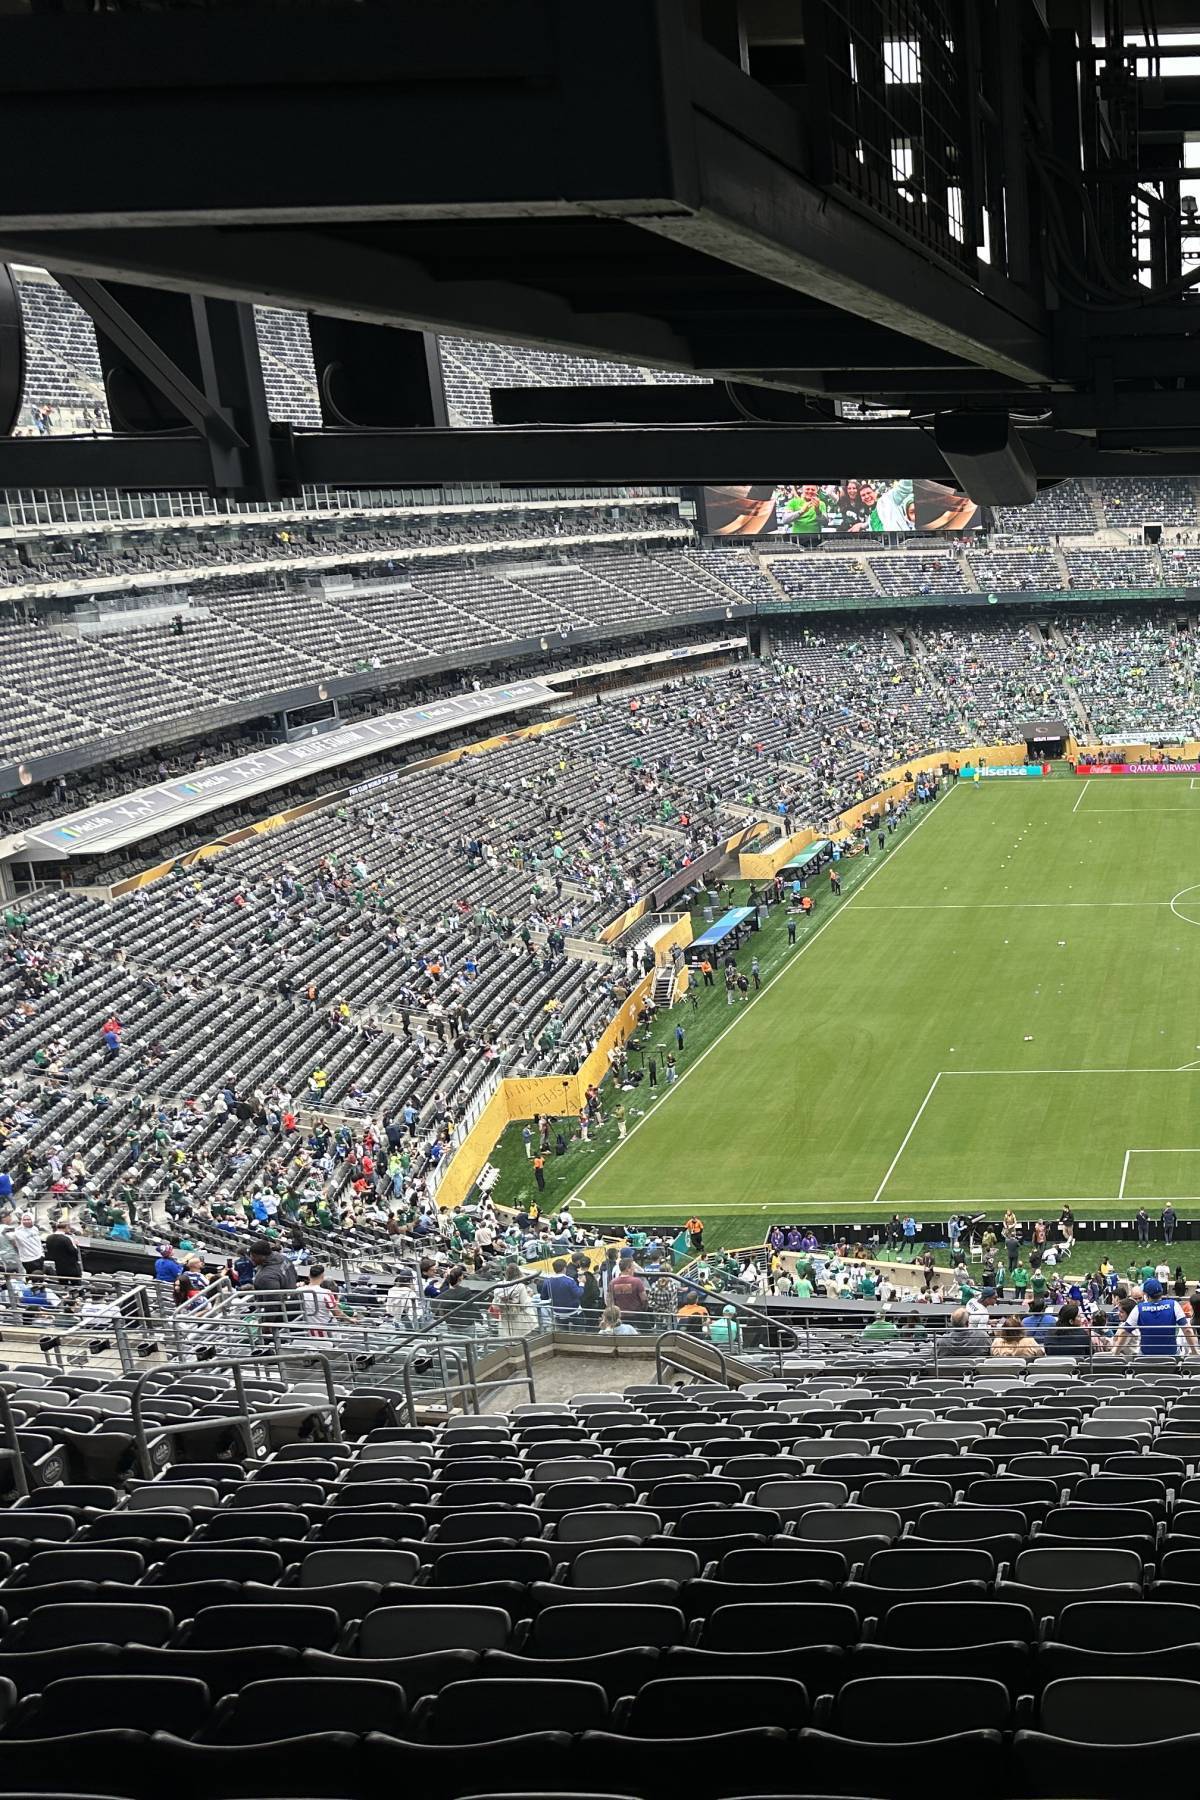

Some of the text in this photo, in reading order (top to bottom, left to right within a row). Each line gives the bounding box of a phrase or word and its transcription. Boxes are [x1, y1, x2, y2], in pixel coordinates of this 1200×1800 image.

[975, 766, 1028, 776] Hisense
[1129, 764, 1197, 773] QATAR AIRWAYS
[71, 817, 113, 834] MetLife
